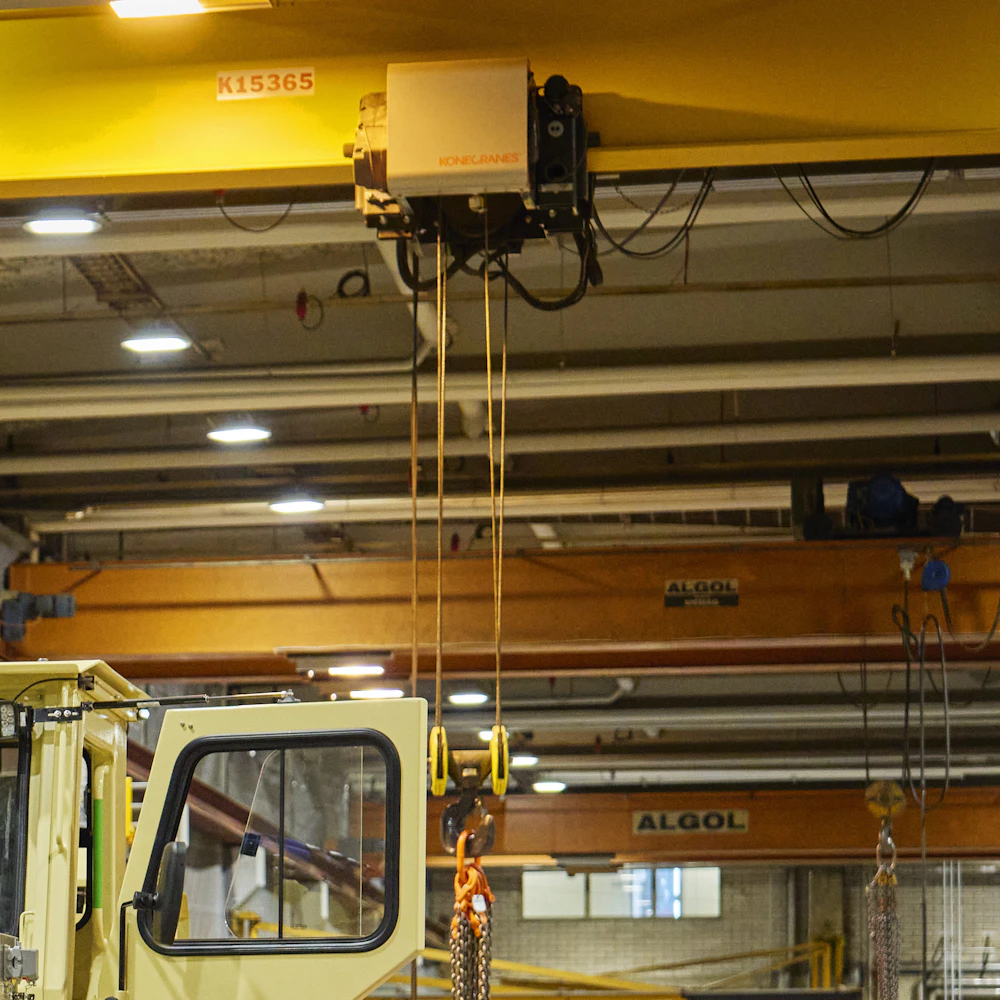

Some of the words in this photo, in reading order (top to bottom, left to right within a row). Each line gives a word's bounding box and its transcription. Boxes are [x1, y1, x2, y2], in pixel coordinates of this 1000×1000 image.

[217, 72, 314, 94] K15365
[438, 152, 520, 167] KONECRANES
[667, 581, 737, 593] ALGOL
[637, 811, 746, 830] ALGOL
